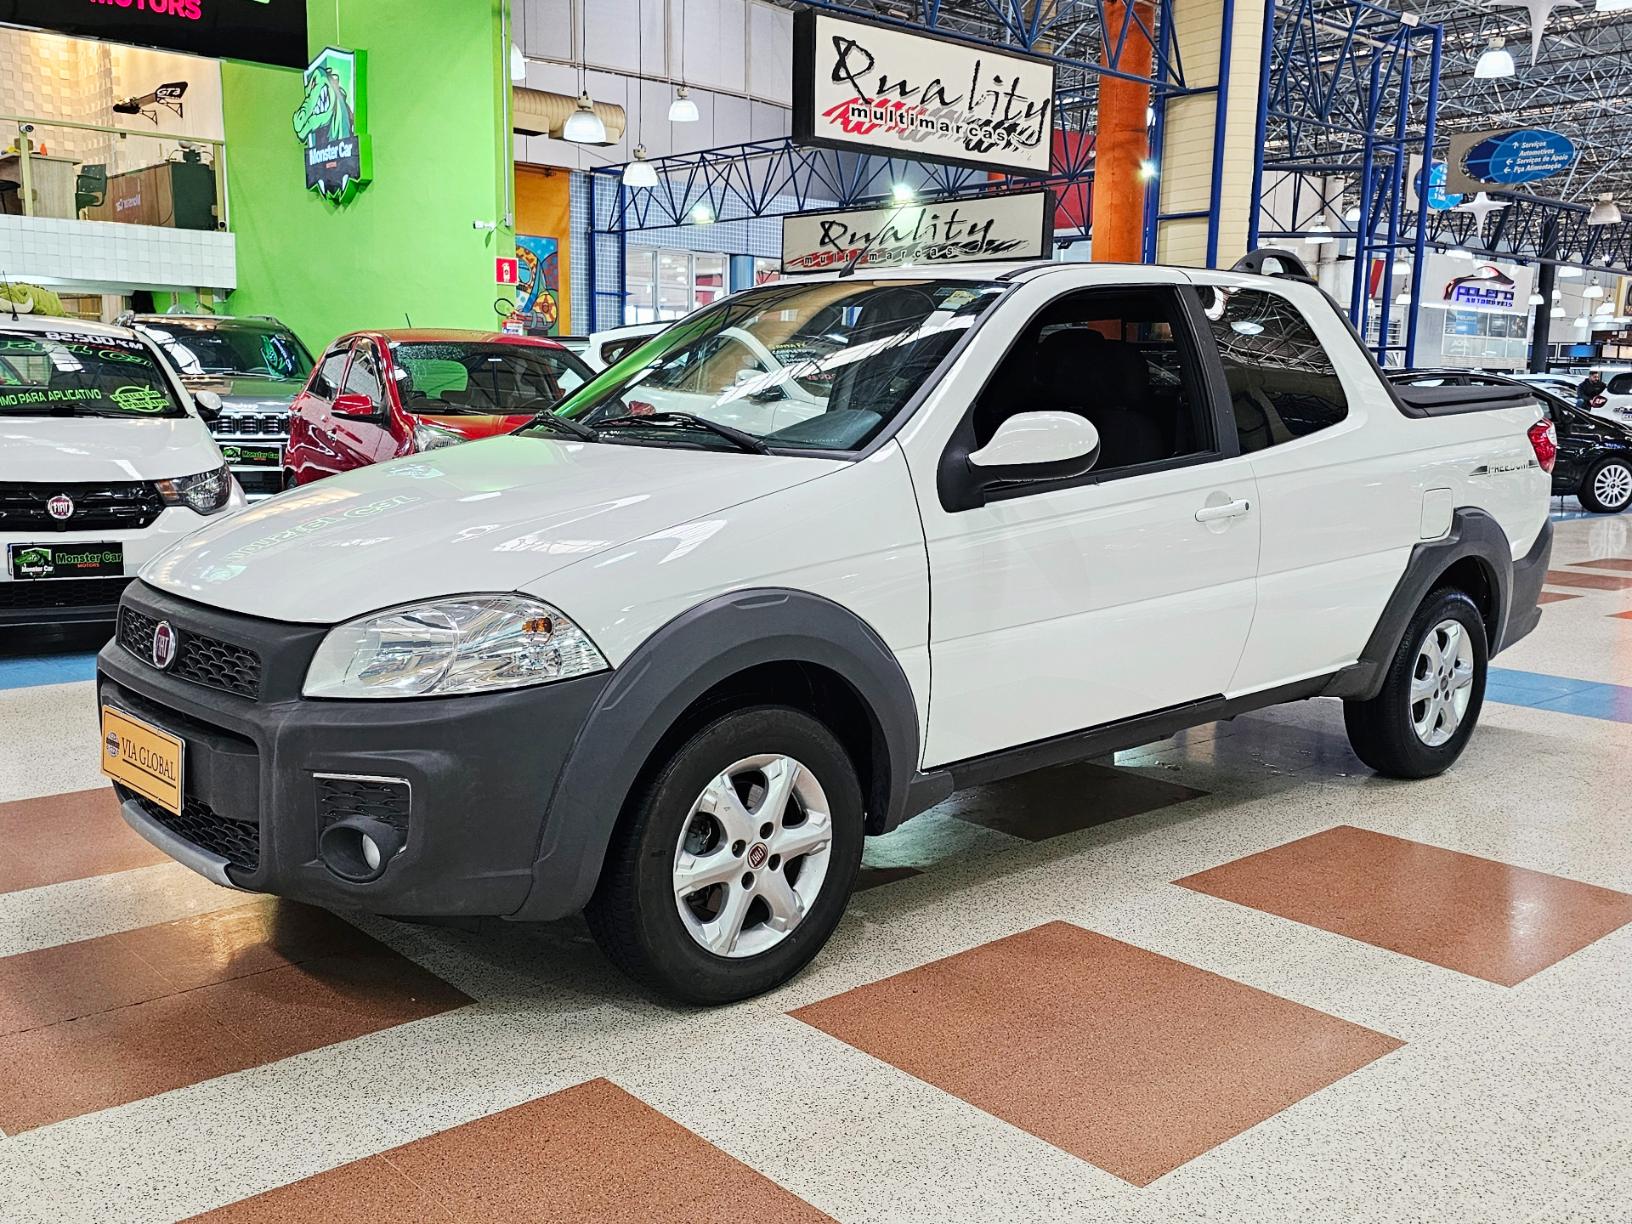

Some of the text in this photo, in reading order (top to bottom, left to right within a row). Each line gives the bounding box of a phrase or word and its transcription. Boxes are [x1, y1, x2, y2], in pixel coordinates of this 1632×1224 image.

[832, 36, 1050, 147] Quality
[850, 104, 1008, 142] multimarcas
[309, 144, 339, 165] Monster
[339, 141, 353, 158] Car
[1521, 141, 1547, 149] Serviços
[1526, 162, 1562, 171] Alimentação
[1551, 153, 1568, 162] Apoio
[820, 208, 994, 253] Quality
[804, 246, 953, 266] multmarcas
[18, 391, 47, 404] PARA
[48, 389, 102, 402] APLICATIVO
[56, 552, 123, 564] Monster Car
[121, 736, 176, 782] VIA GLOBAL
[751, 847, 764, 864] FIAT
